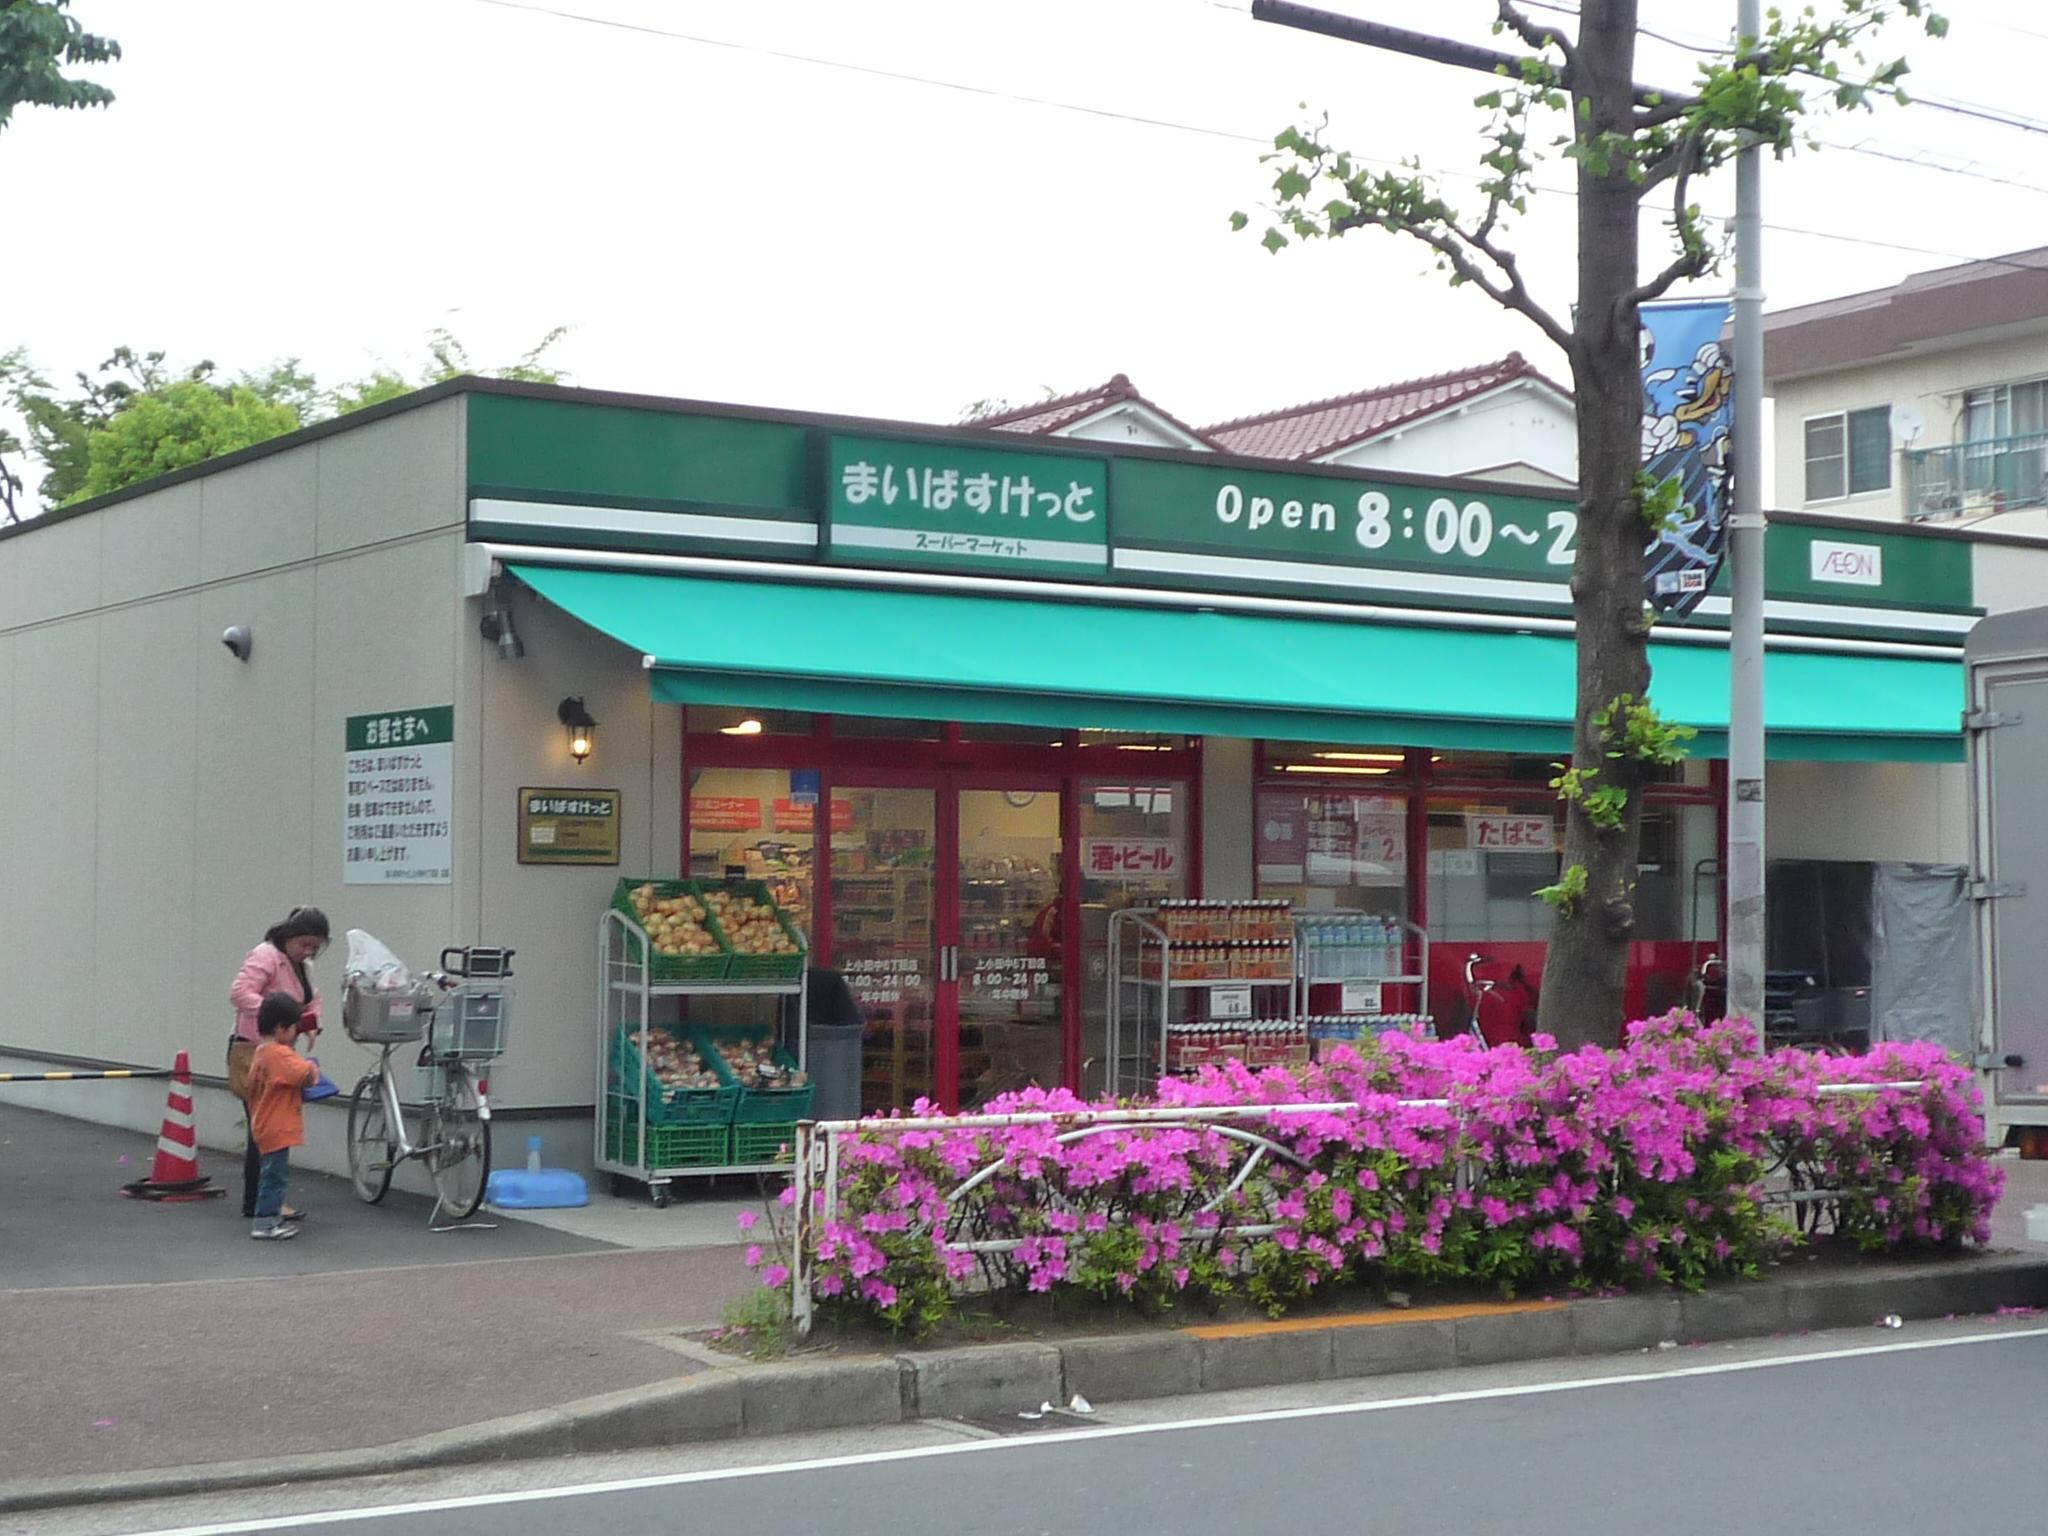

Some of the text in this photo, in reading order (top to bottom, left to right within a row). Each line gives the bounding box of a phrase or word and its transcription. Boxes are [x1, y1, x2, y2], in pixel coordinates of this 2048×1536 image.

[842, 461, 1096, 522] まいばすけっと
[1215, 484, 1336, 532] Open
[915, 533, 1028, 556] スーパーマーケット
[366, 716, 429, 744] お客さまへ
[529, 799, 611, 815] まいばすけっと
[1478, 821, 1545, 846] たばこ
[1091, 845, 1174, 871] 酒・ビール
